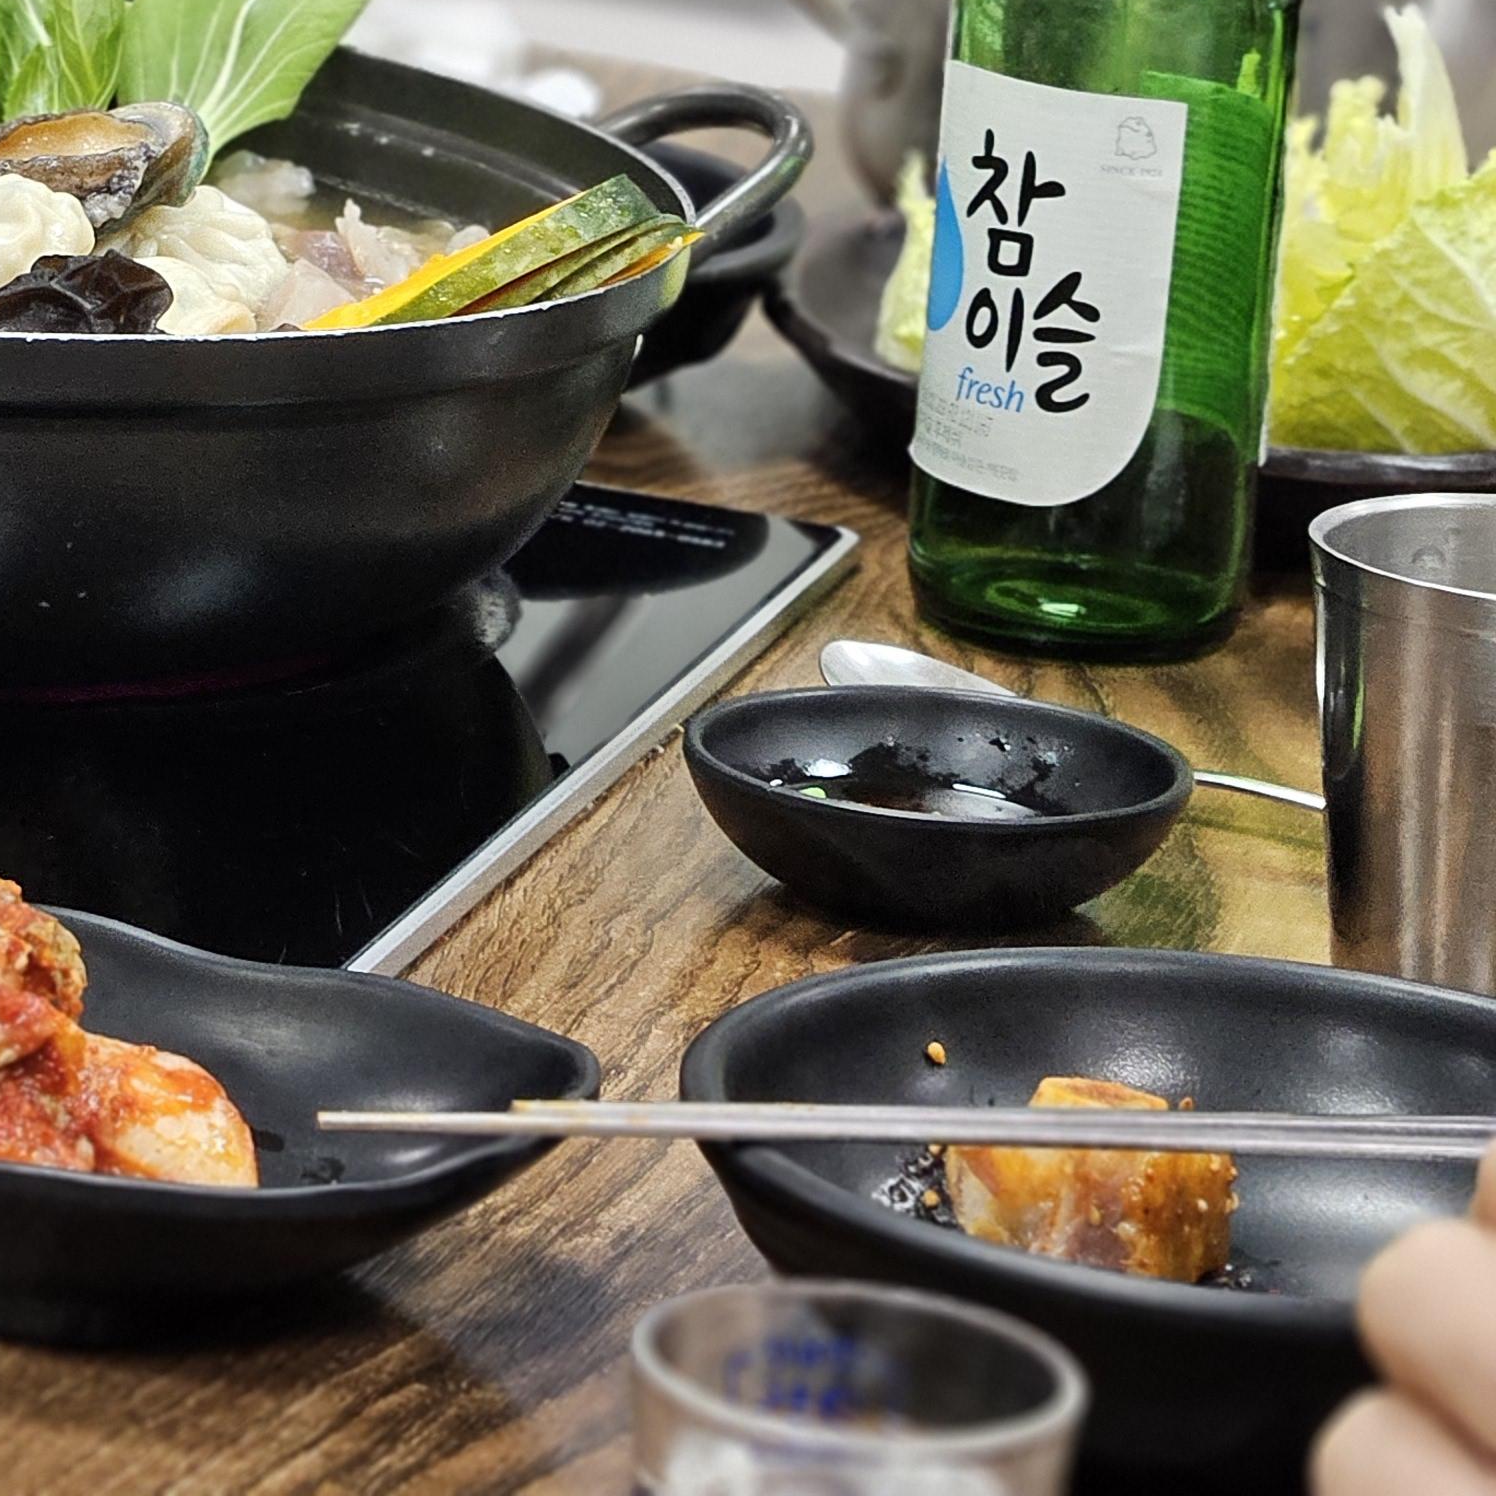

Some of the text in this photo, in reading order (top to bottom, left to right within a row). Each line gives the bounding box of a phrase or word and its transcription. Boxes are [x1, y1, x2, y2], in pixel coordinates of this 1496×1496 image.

[966, 128, 1066, 277] 참
[956, 367, 1024, 413] fresh
[966, 271, 1101, 413] 이슬
